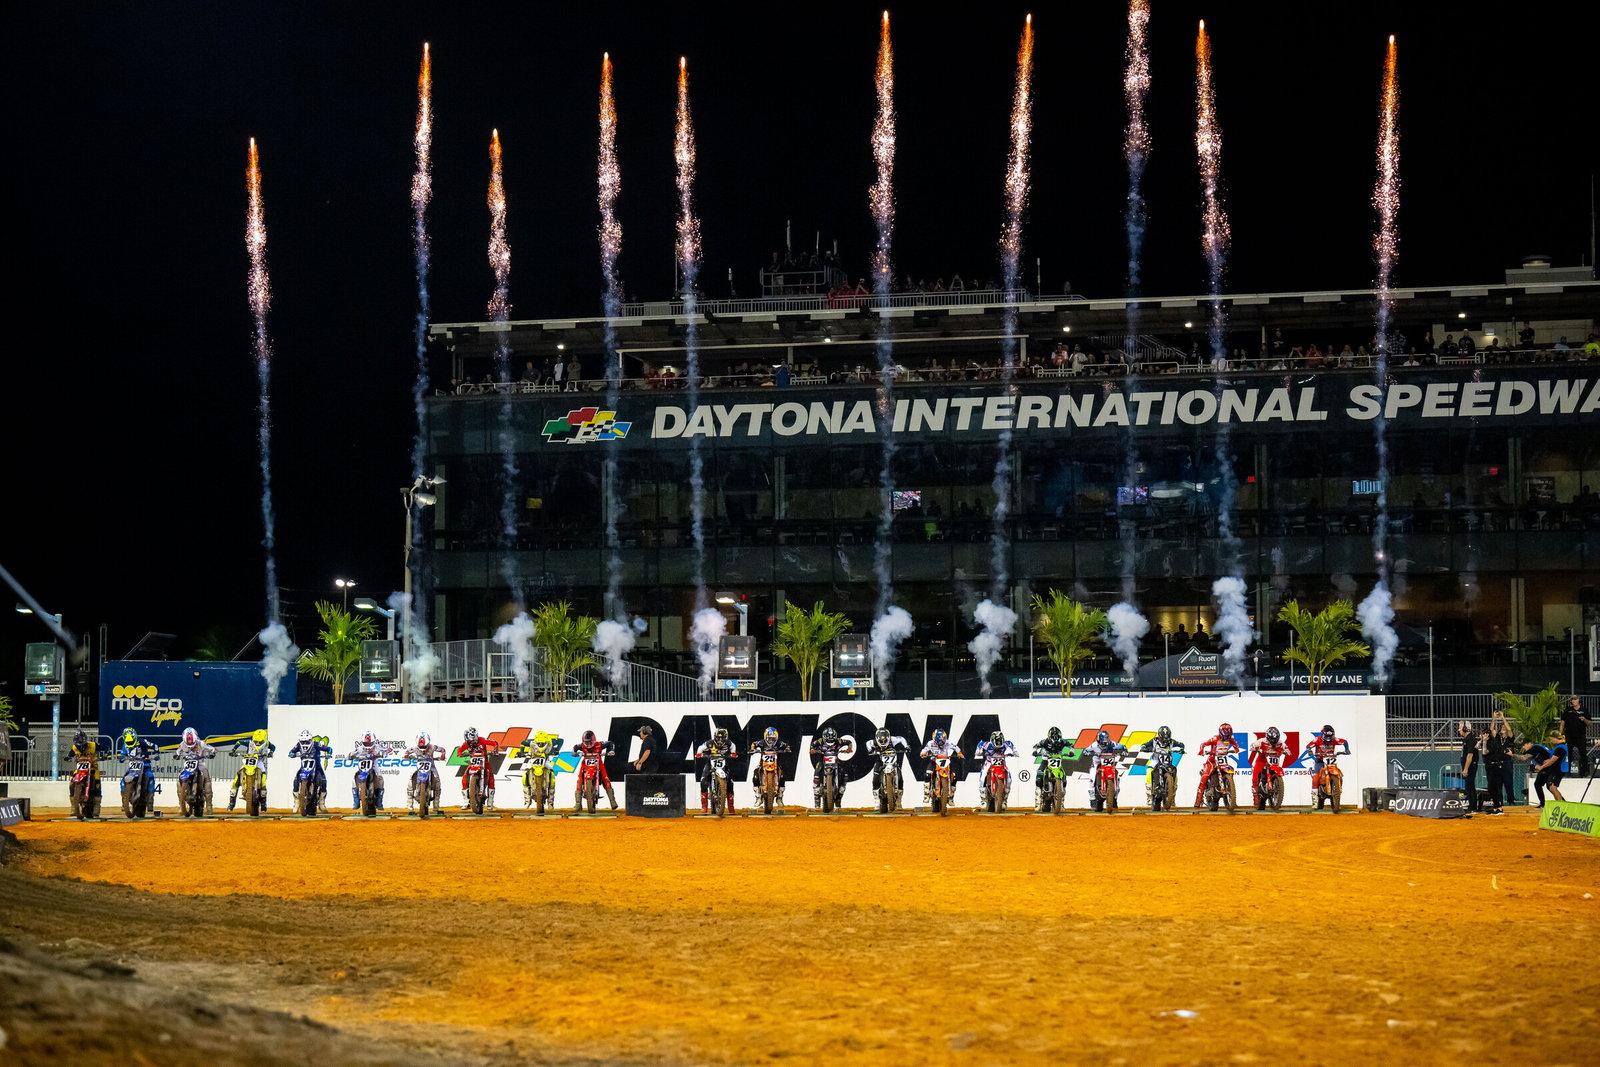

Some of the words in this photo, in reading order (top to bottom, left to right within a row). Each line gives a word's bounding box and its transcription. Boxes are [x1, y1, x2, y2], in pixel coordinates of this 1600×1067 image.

[650, 401, 877, 438] DAYTONA
[892, 387, 1329, 432] INTERNATIONAL
[1037, 677, 1080, 686] VICTORY
[1083, 677, 1110, 686] LANE
[1290, 675, 1333, 684] VICTORY
[1335, 675, 1363, 684] LANE
[111, 698, 183, 711] MUSCO
[150, 709, 183, 728] Lighting
[607, 711, 1002, 782] DAYTONA
[472, 757, 482, 765] 95
[765, 755, 775, 763] 25
[884, 756, 895, 764] 27
[939, 759, 947, 767] 1
[1050, 759, 1061, 767] 21
[1160, 755, 1169, 764] 14
[1217, 756, 1228, 764] 51
[185, 760, 197, 769] 35
[303, 760, 314, 768] 11
[360, 760, 370, 769] 91
[419, 761, 429, 770] 26
[713, 760, 723, 768] 15
[1401, 772, 1427, 780] Ruoff
[1406, 798, 1441, 810] OAKLEY
[1557, 811, 1595, 833] Kawasaki
